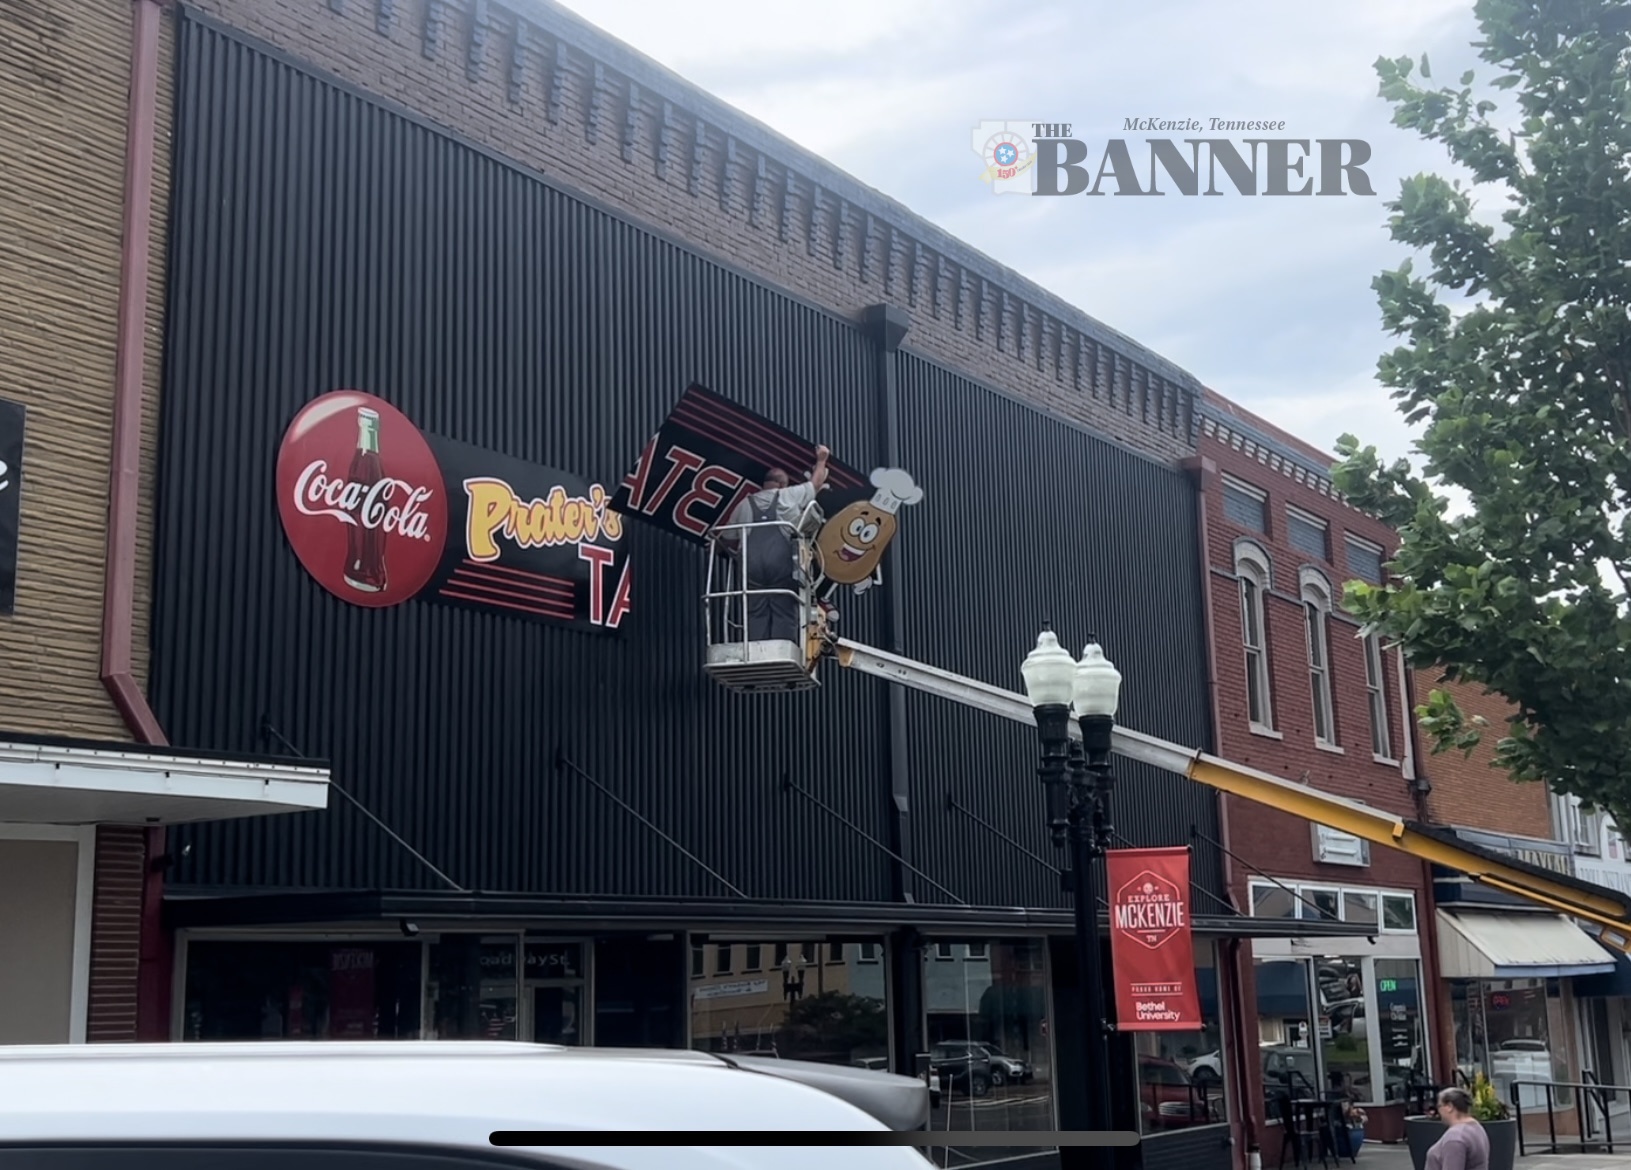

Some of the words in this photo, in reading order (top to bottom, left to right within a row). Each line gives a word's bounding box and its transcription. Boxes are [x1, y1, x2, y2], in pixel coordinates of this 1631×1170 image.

[463, 477, 623, 562] Prater's
[1127, 893, 1170, 903] EXPLORE
[1114, 902, 1185, 929] MCKENZIE
[1146, 935, 1157, 943] TN
[1380, 980, 1397, 992] OPEN
[1135, 1001, 1165, 1012] Bethel
[1136, 1010, 1181, 1022] University
